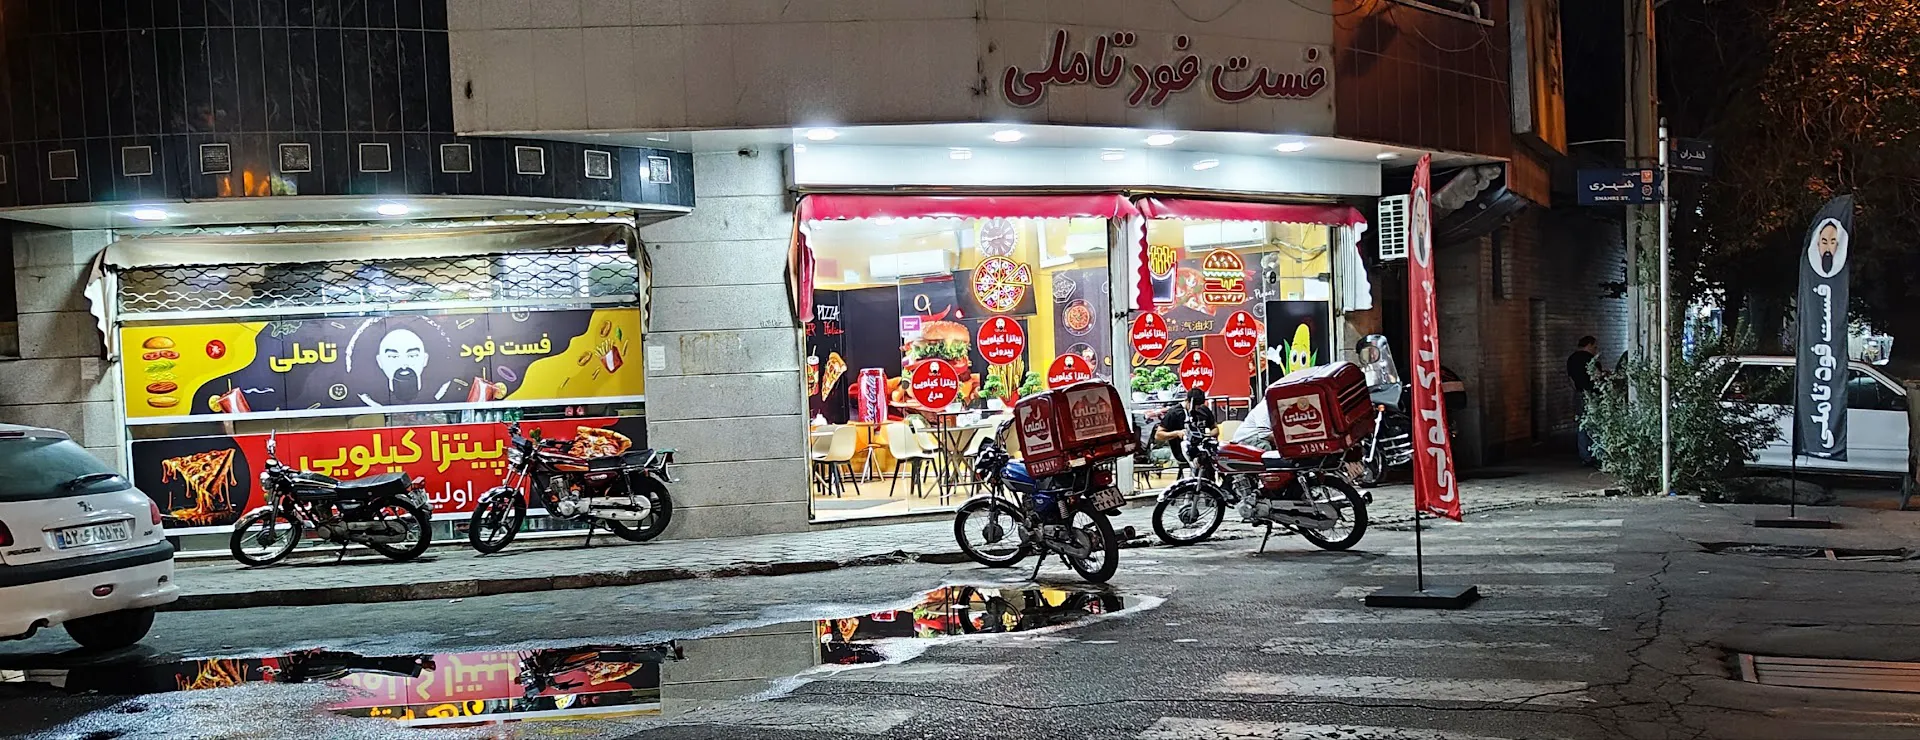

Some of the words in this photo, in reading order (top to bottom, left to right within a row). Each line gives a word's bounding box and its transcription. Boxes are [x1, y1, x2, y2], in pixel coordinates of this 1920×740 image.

[1002, 28, 1137, 108] تاملی
[1127, 34, 1201, 108] فود
[1211, 47, 1327, 104] فست
[816, 304, 840, 321] PIZZA
[1813, 284, 1832, 342] فست
[459, 335, 496, 363] فود
[500, 333, 551, 356] فست
[980, 334, 1005, 346] کیلویی
[1006, 333, 1022, 346] پیتزا
[270, 341, 338, 373] تاملی
[1811, 343, 1837, 382] فود
[913, 378, 939, 390] کیلویی
[927, 390, 944, 403] مرغ
[941, 378, 957, 390] پیتزا
[1810, 383, 1835, 449] تاملی
[299, 428, 423, 478] کیلویی
[431, 430, 506, 476] پیتزا
